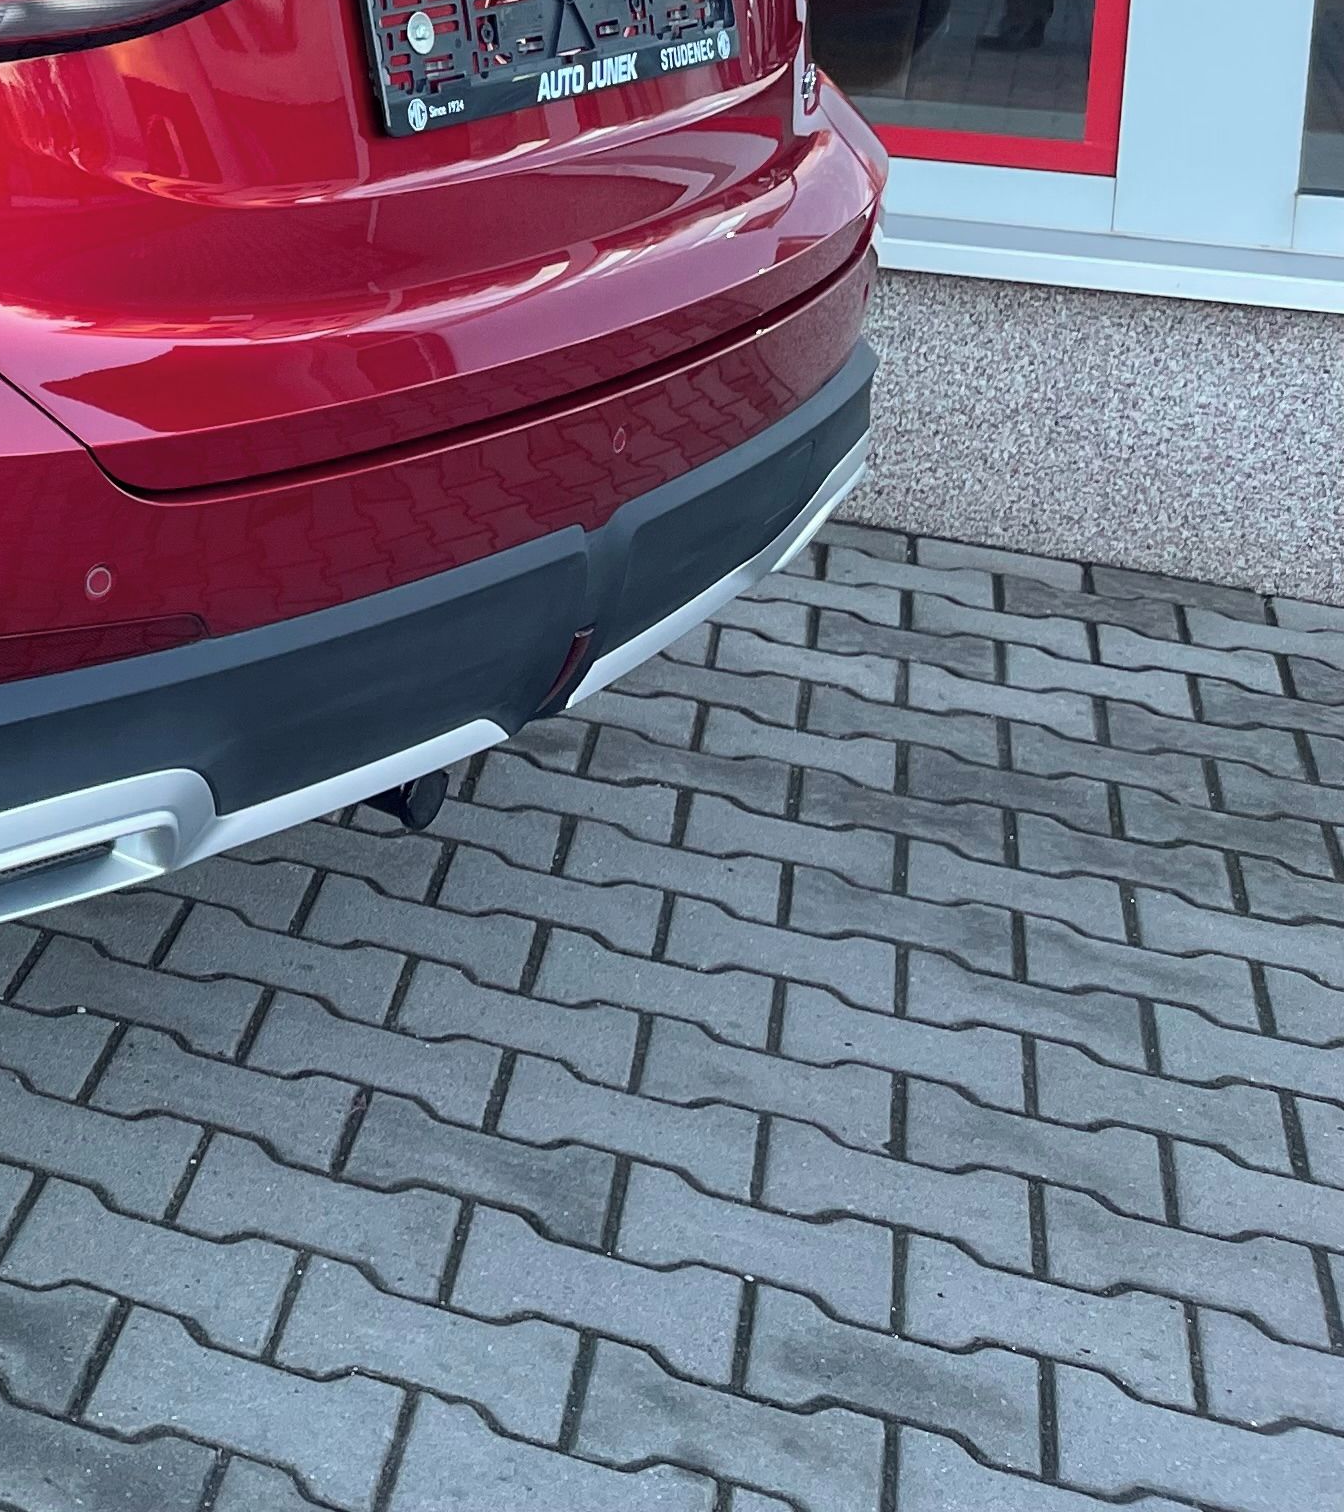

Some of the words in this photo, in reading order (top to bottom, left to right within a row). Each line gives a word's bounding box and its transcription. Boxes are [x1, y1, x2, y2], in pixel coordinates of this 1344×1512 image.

[661, 38, 715, 71] STUDENEC
[537, 65, 585, 102] AUTO
[588, 52, 639, 91] JUNEK
[429, 105, 447, 118] Since
[448, 99, 464, 114] 1924
